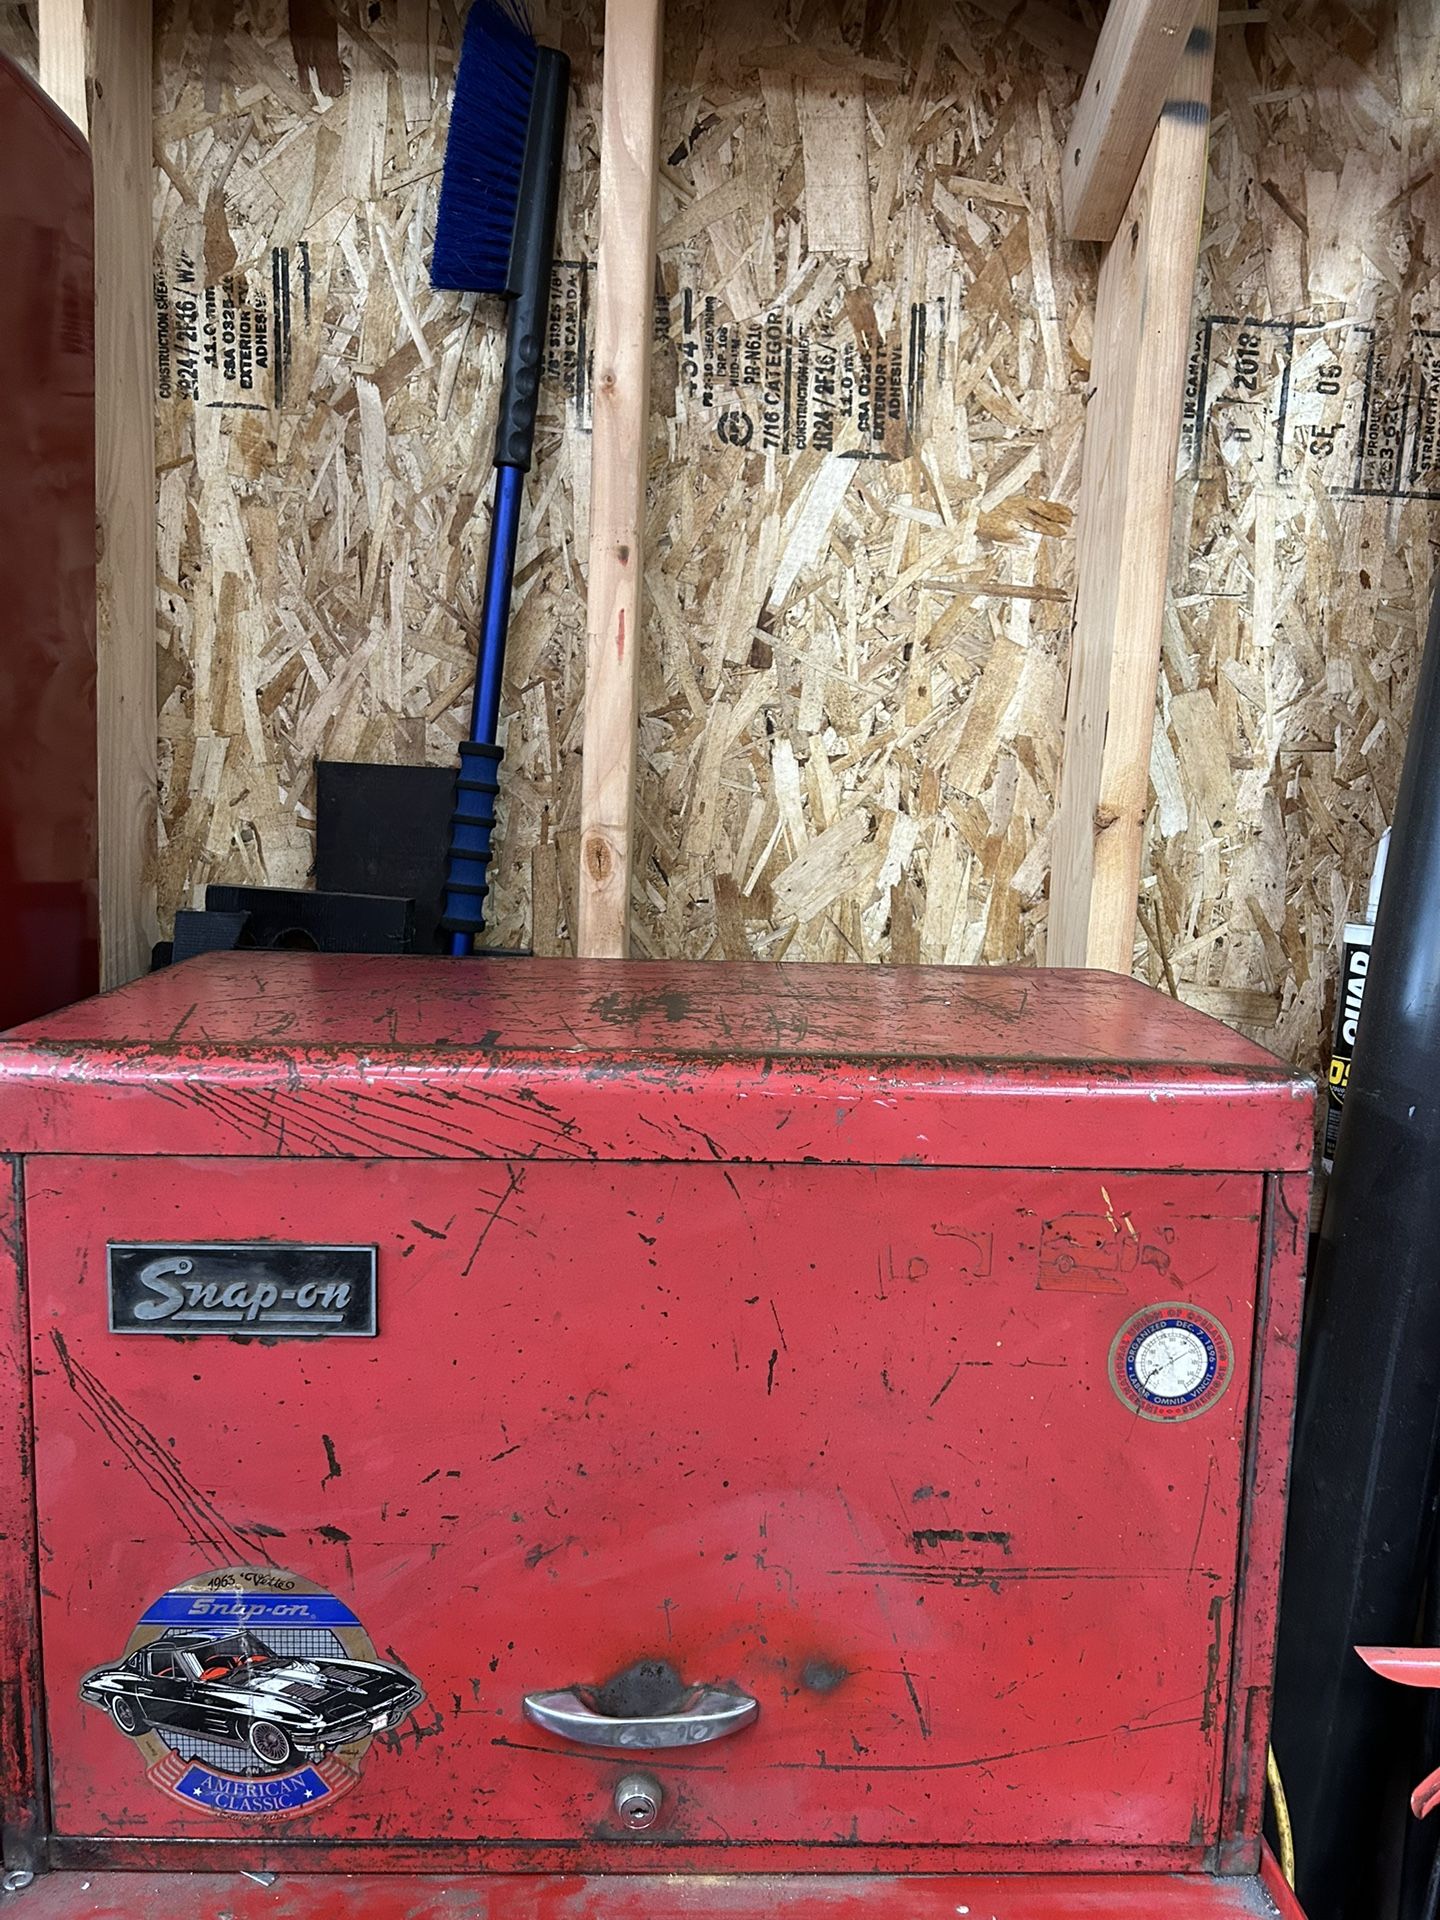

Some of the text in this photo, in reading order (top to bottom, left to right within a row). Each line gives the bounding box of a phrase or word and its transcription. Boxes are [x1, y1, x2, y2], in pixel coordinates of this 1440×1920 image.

[205, 286, 216, 319] mm
[550, 270, 562, 300] 1/8"
[549, 304, 561, 347] SIDES
[158, 313, 170, 399] CONSTRUCTION
[224, 349, 236, 380] CSA
[240, 311, 252, 389] EXTERIOR
[1233, 333, 1261, 390] 2018
[796, 366, 808, 450] CONSTRUCTION
[840, 377, 853, 417] 11.0
[857, 401, 870, 432] CSA
[873, 364, 887, 440] EXTERIOR
[1184, 402, 1196, 418] IN
[763, 411, 780, 449] 7/16
[1367, 399, 1382, 457] PRODUCT
[1421, 398, 1438, 470] STRENGTH
[134, 1257, 351, 1320] Snap-on
[1127, 1321, 1167, 1362] ORGANIZED
[1176, 1320, 1195, 1332] DEC.
[1204, 1340, 1215, 1362] 1896
[1153, 1396, 1187, 1405] OMNIA
[1190, 1374, 1212, 1397] VINCIT
[208, 1574, 236, 1591] 1963
[187, 1598, 310, 1621] Snap-on
[201, 1775, 306, 1797] AMERICAN
[215, 1794, 292, 1811] CLASSIC
